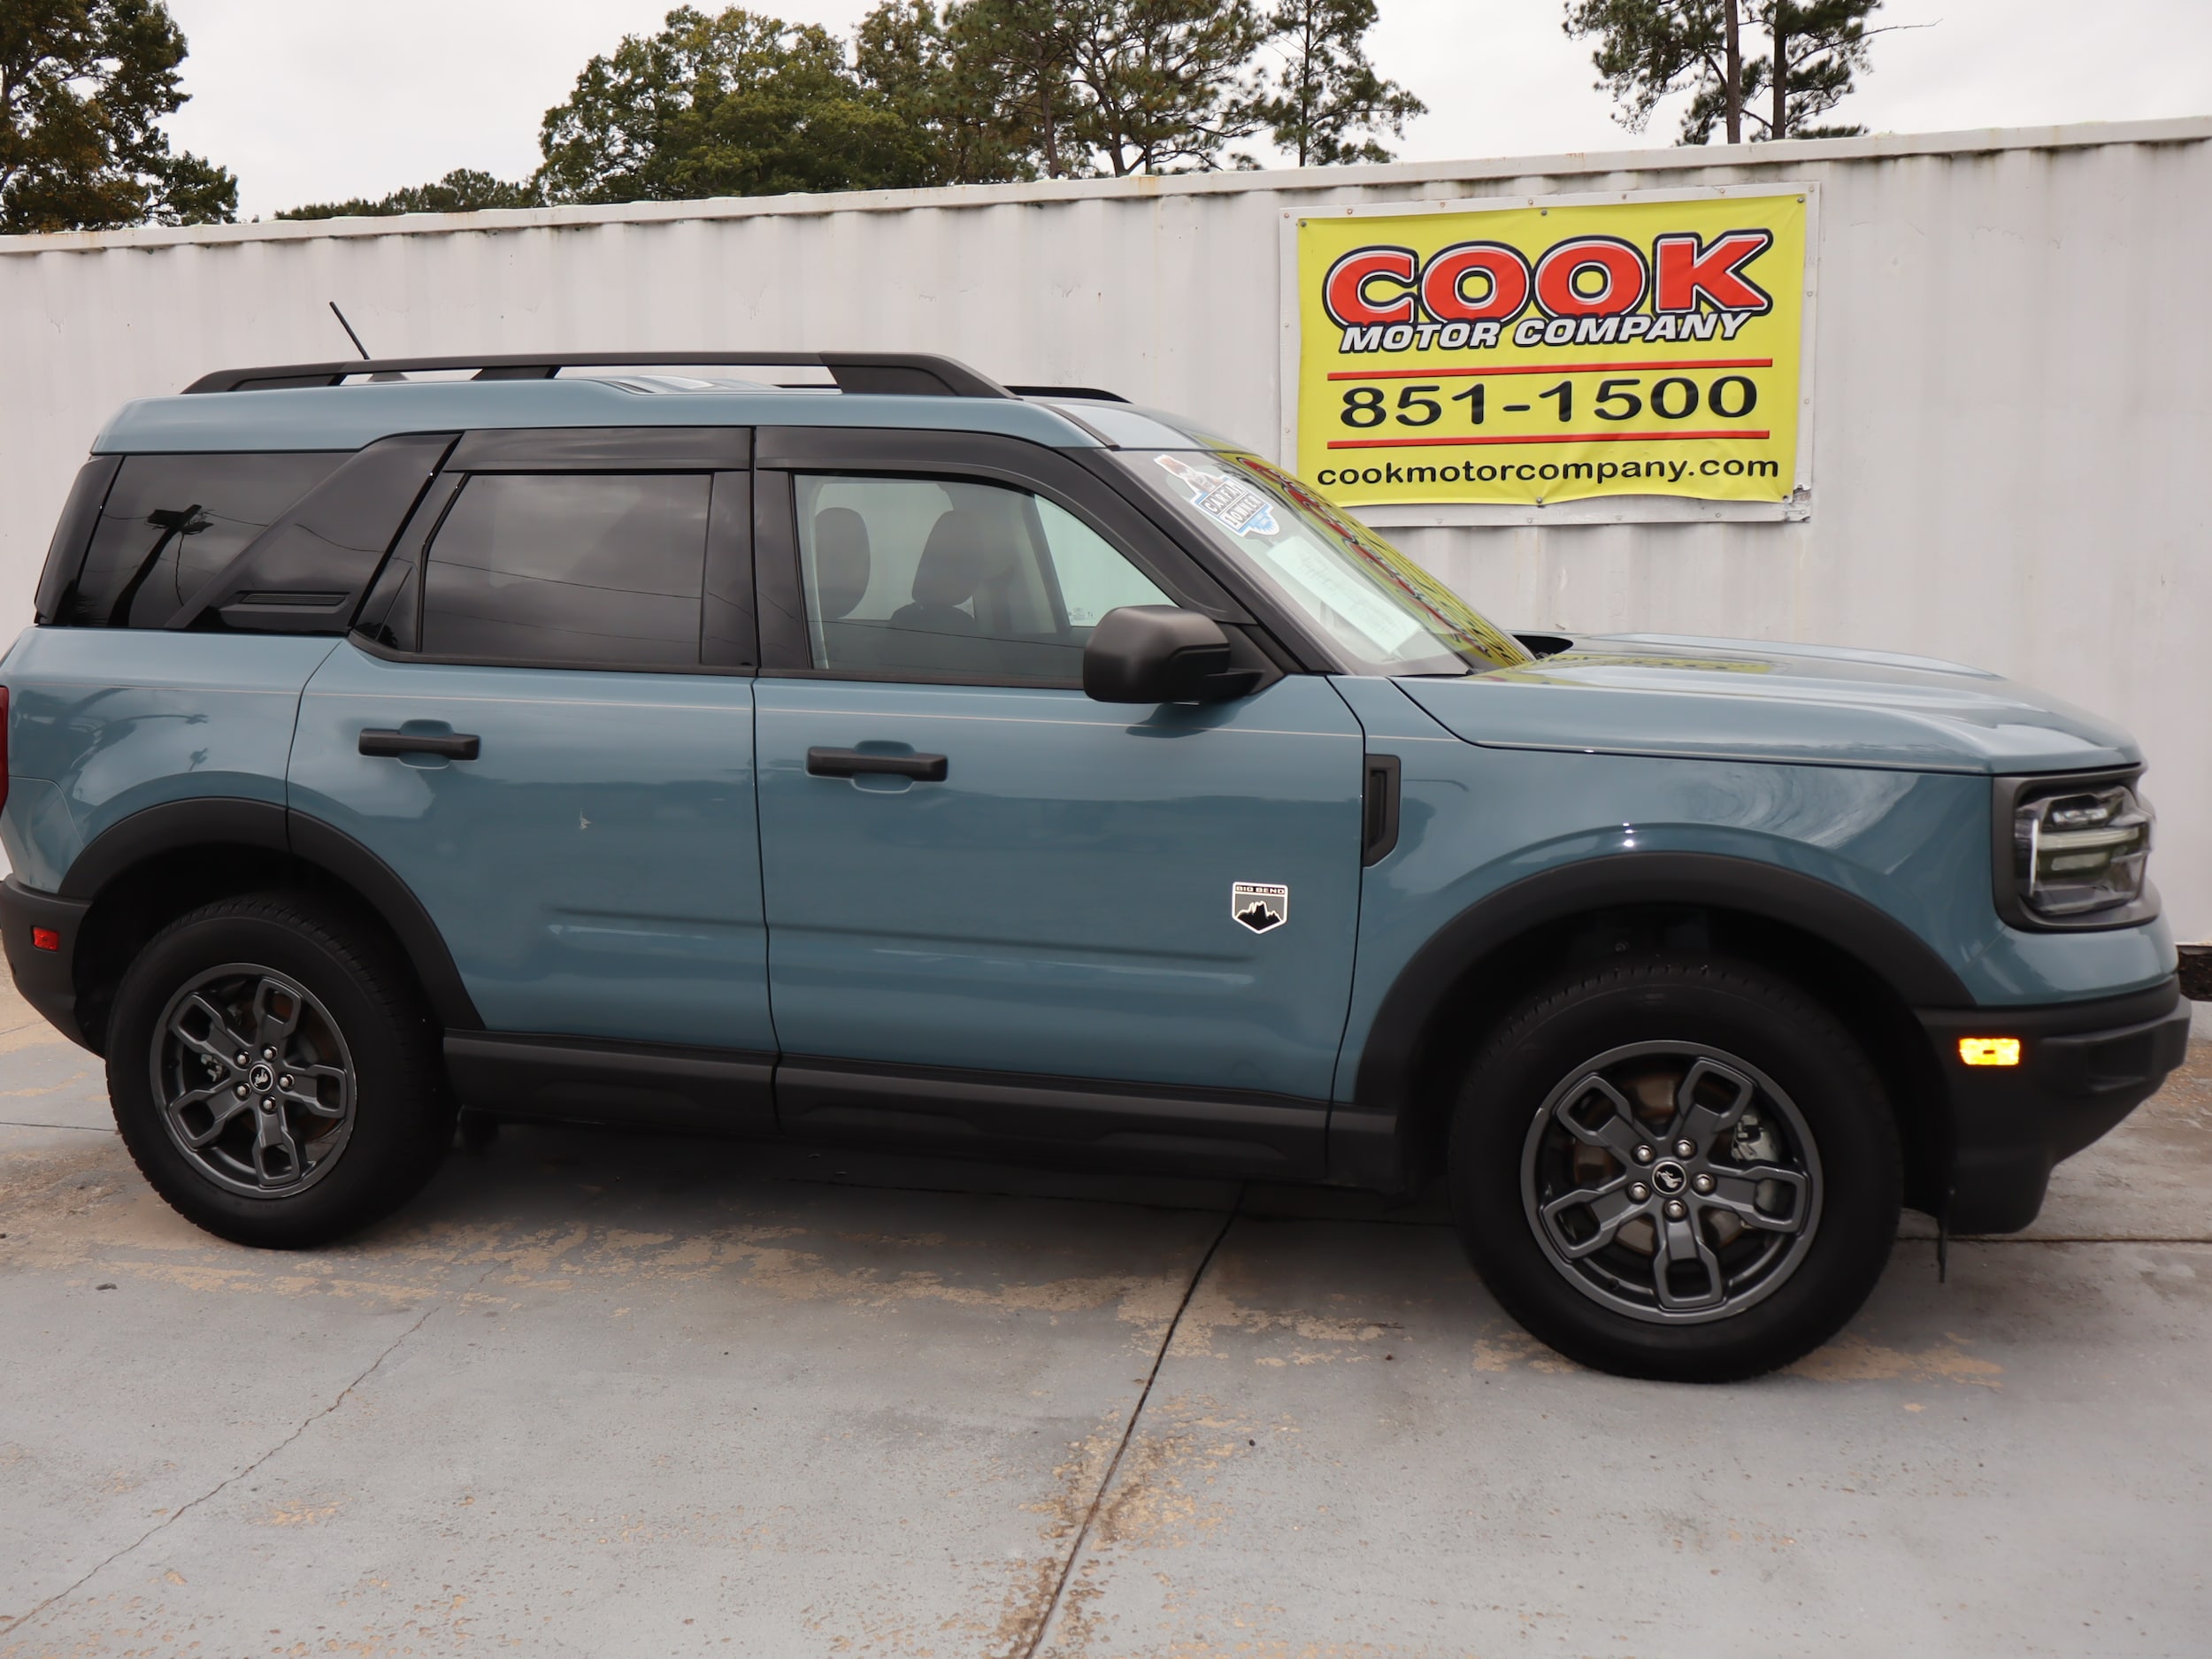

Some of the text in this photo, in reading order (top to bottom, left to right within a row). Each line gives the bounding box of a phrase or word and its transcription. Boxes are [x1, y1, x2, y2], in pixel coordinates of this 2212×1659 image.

[1323, 228, 1772, 327] COOK
[1339, 311, 1752, 352] MOTOR COMPANY
[1340, 375, 1758, 428] 851-1500
[1317, 457, 1779, 484] cookmotorcompany.com
